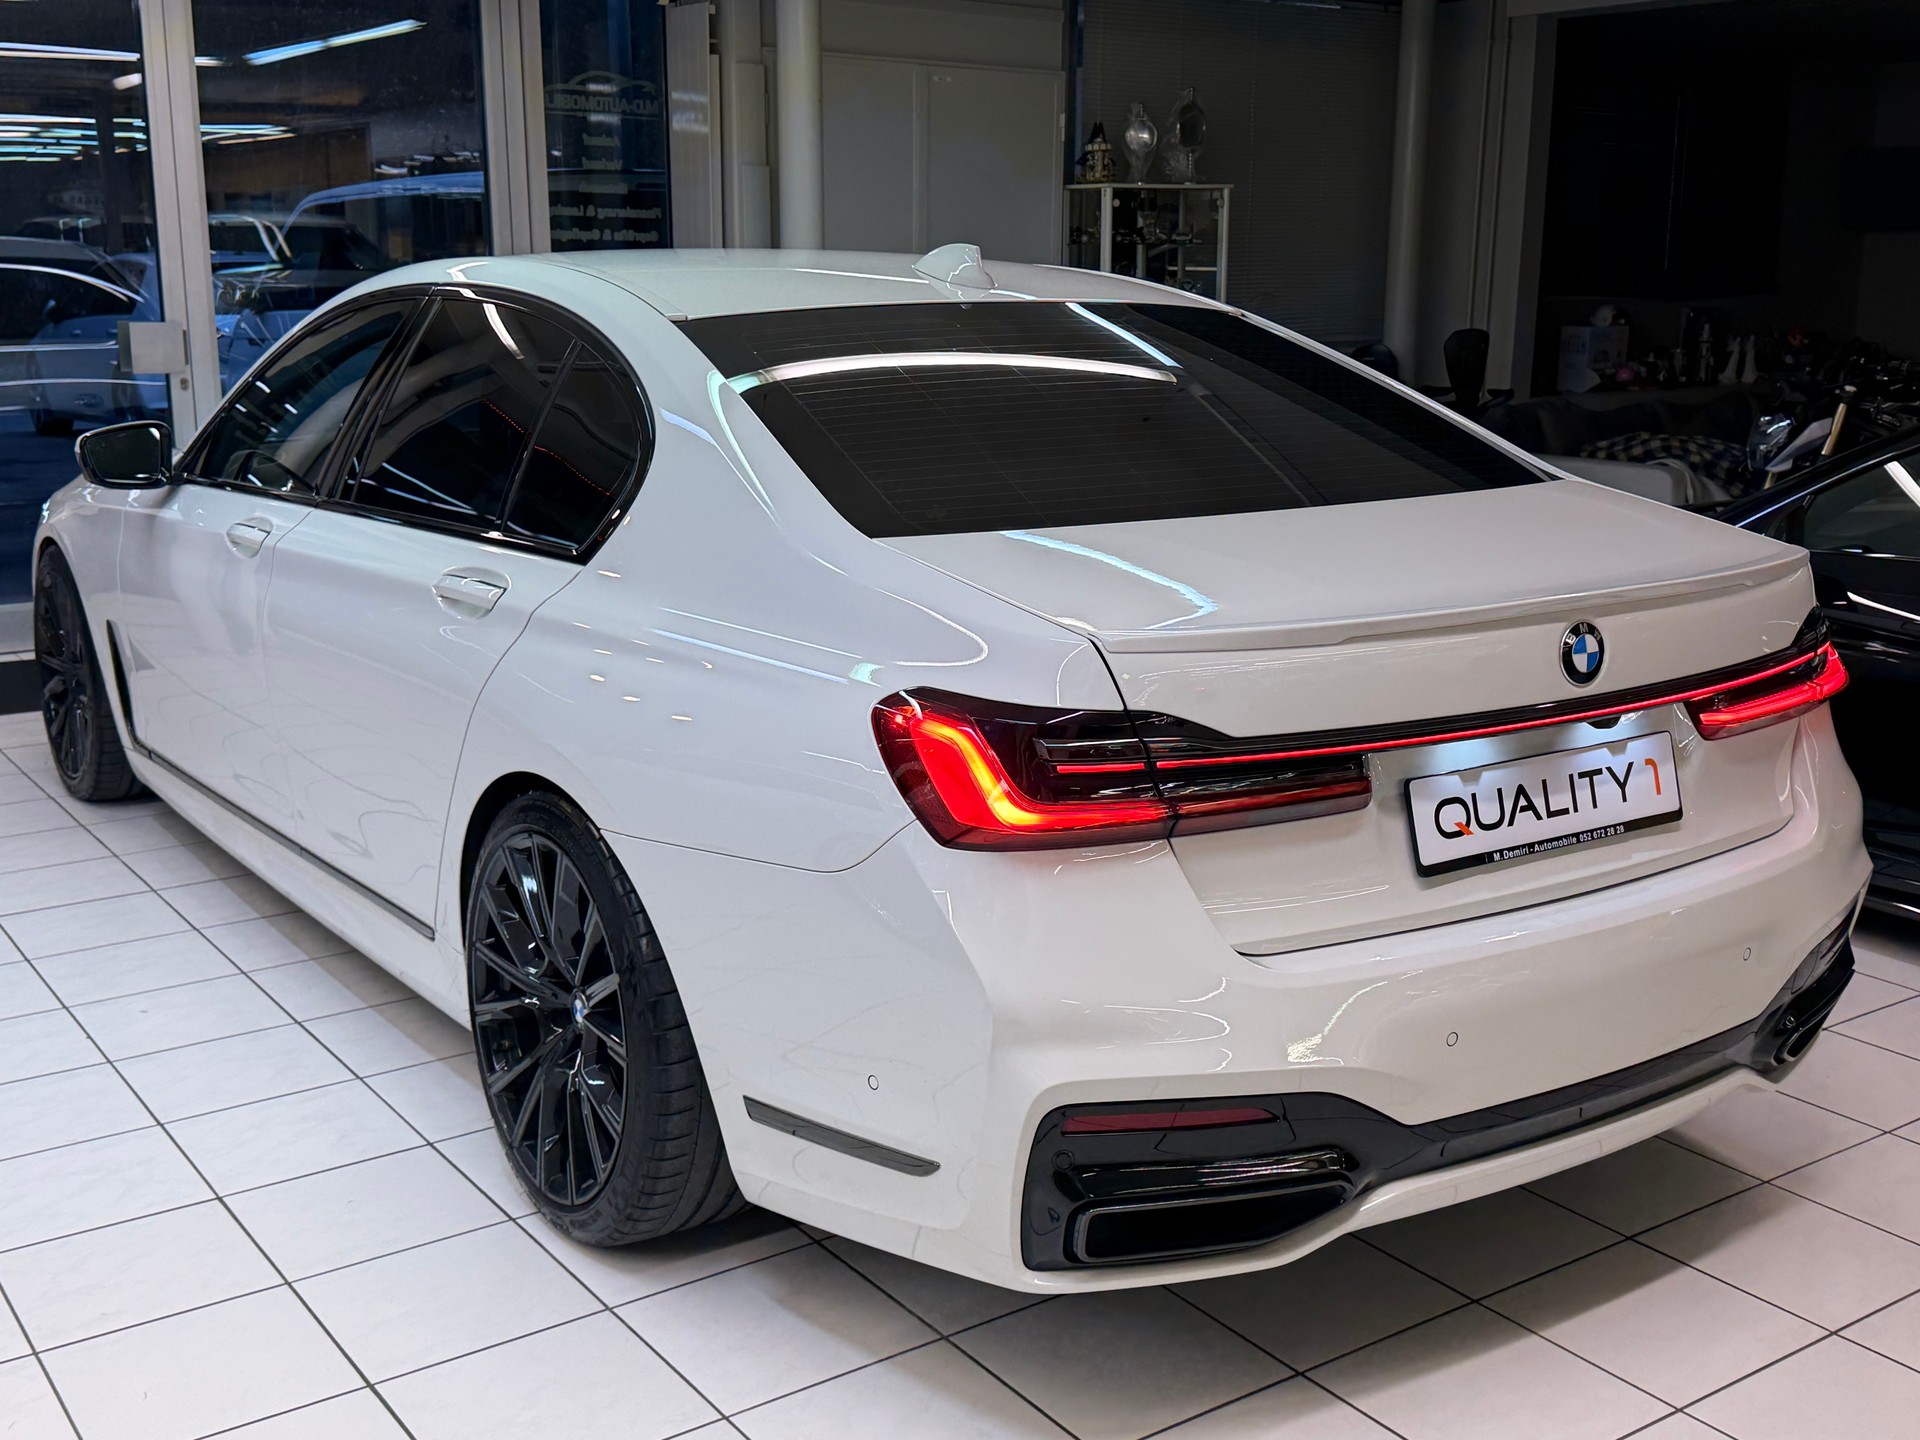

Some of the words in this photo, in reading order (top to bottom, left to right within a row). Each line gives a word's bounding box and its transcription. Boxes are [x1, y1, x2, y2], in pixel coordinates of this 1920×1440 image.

[1534, 835, 1577, 853] Automobile
[1579, 832, 1592, 842] 052
[1593, 829, 1606, 839] 672
[1606, 827, 1615, 836] 28
[1616, 825, 1625, 834] 28
